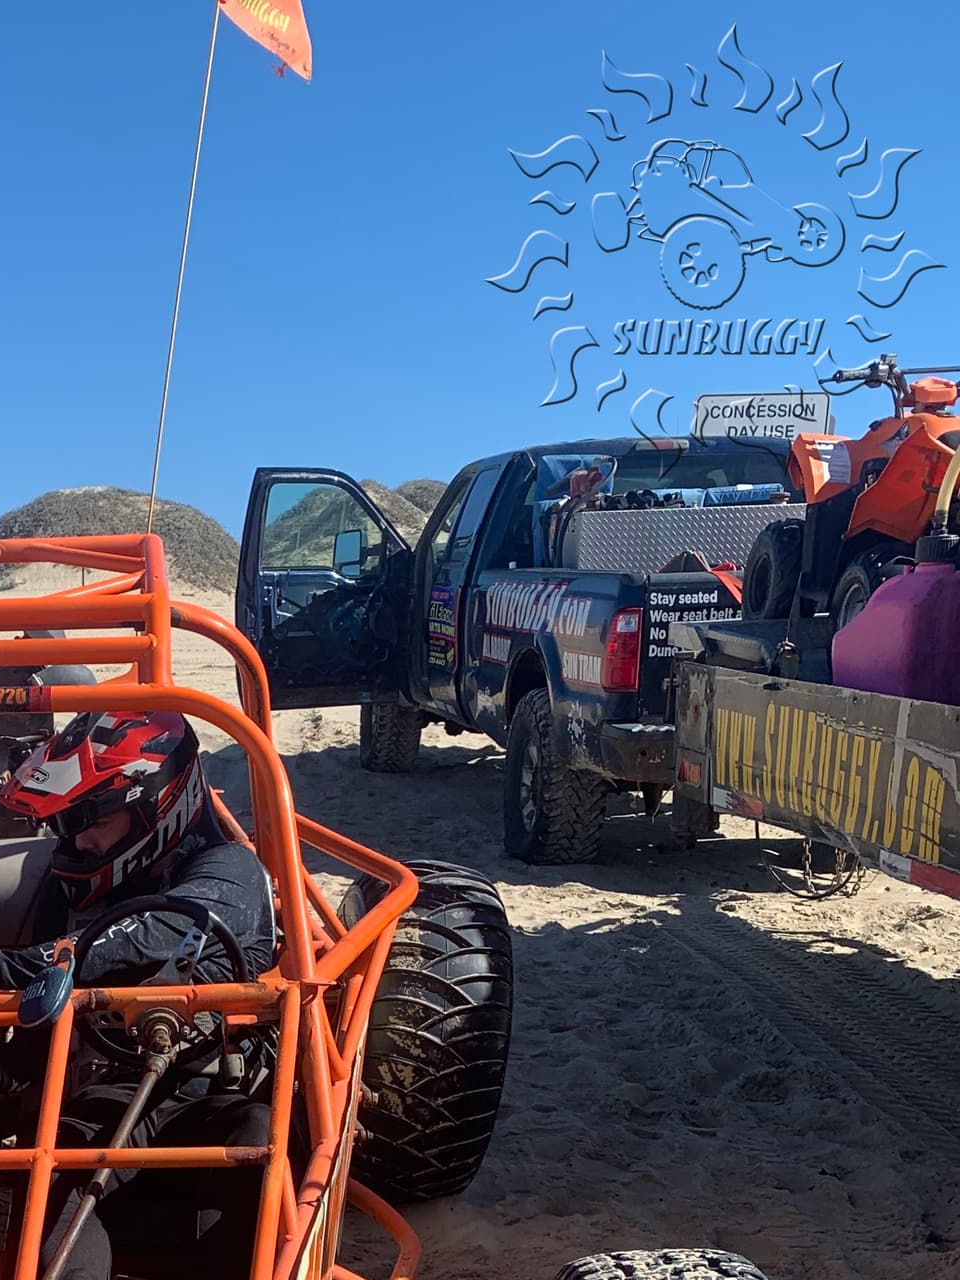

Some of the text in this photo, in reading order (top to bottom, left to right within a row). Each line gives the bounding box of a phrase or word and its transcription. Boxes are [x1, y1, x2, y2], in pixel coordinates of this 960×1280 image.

[709, 403, 816, 419] CONCESSION
[727, 424, 795, 438] DAY USE
[649, 590, 718, 607] Stay seated
[649, 609, 681, 622] Wear
[682, 608, 708, 622] seat
[709, 607, 734, 621] belt
[649, 627, 667, 640] No
[648, 644, 679, 657] Dune
[562, 651, 578, 680] SUN
